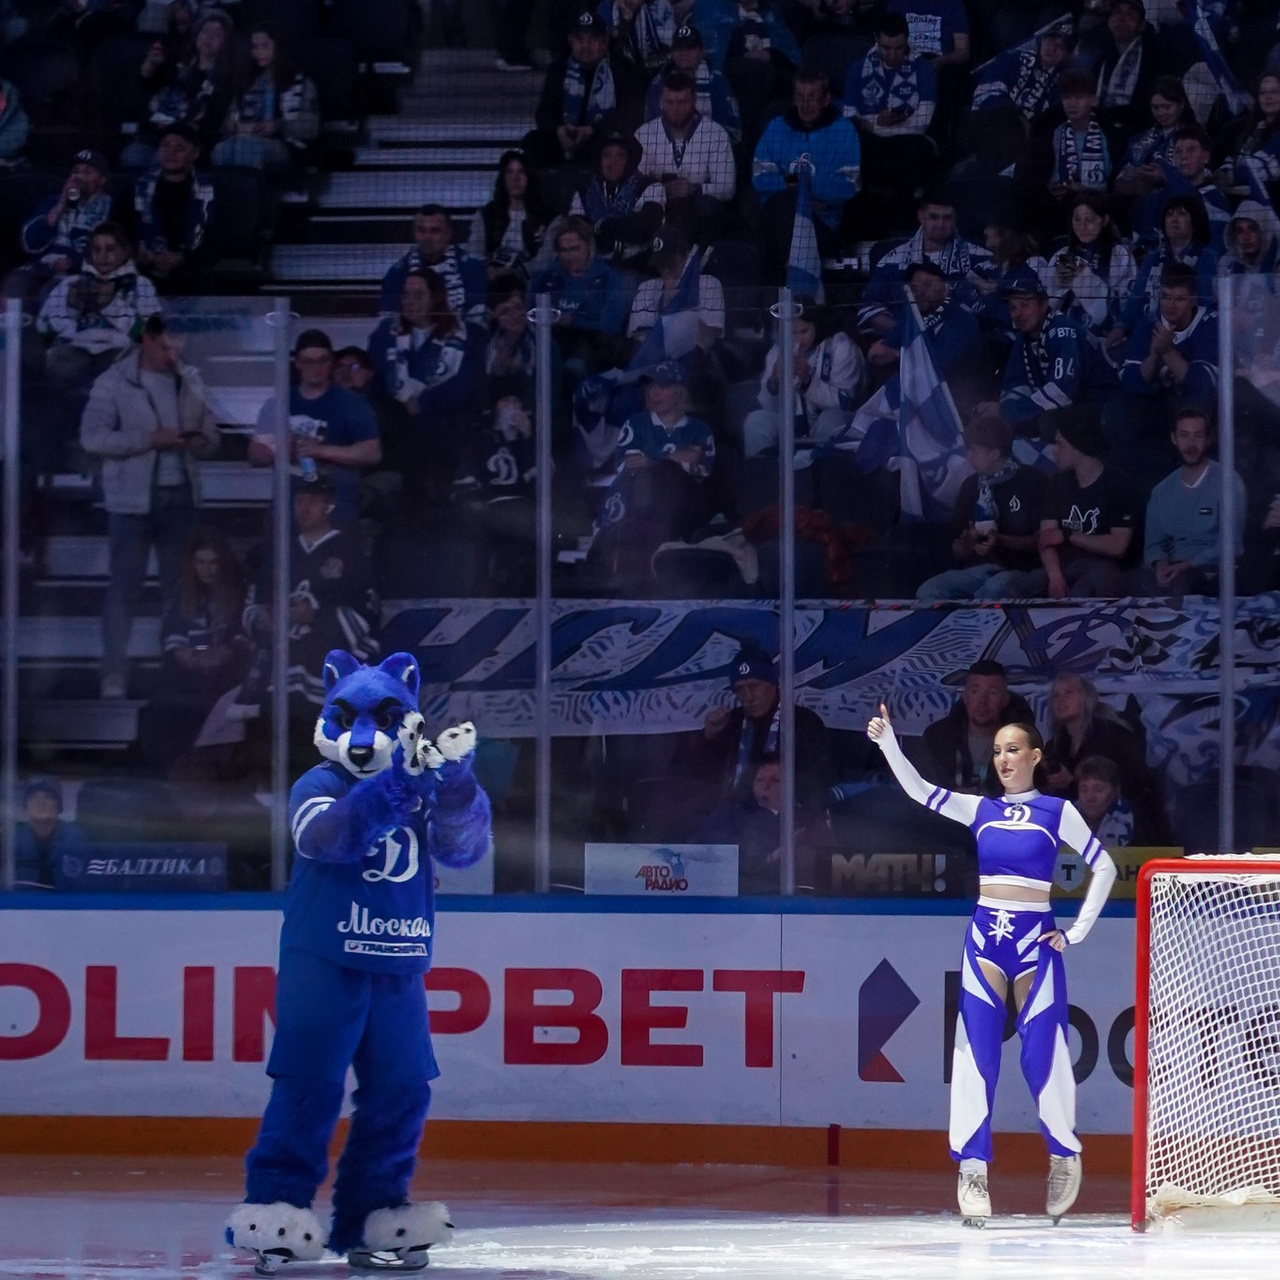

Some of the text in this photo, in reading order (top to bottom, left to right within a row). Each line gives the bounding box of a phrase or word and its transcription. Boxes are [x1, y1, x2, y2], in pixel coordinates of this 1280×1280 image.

[1054, 357, 1076, 380] 84
[104, 857, 206, 876] БАЛТИКА
[634, 864, 670, 878] АВТО
[645, 877, 689, 893] РАДИО
